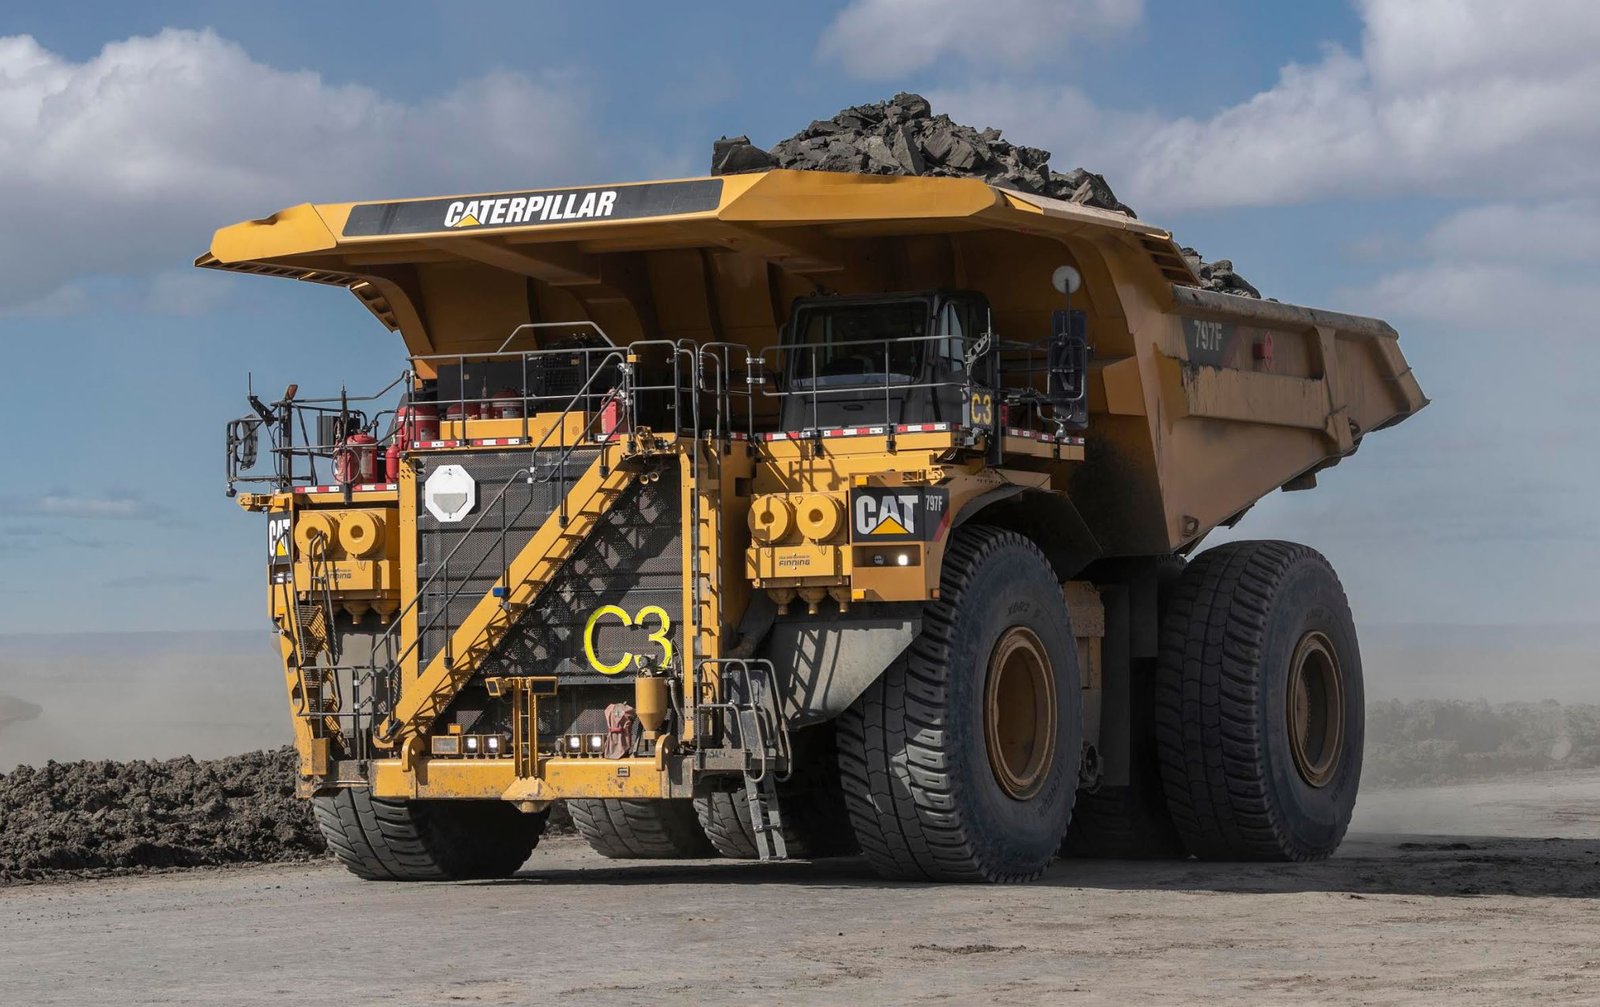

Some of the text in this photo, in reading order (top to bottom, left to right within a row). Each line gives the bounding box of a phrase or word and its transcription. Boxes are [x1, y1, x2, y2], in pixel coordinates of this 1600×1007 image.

[444, 191, 617, 228] CATERPILLAR
[1193, 320, 1222, 351] 797F
[971, 393, 992, 425] C3
[855, 494, 919, 535] CAT
[925, 495, 943, 511] 797F
[269, 519, 290, 556] CAT
[779, 559, 810, 567] FINNING
[583, 604, 673, 675] C3
